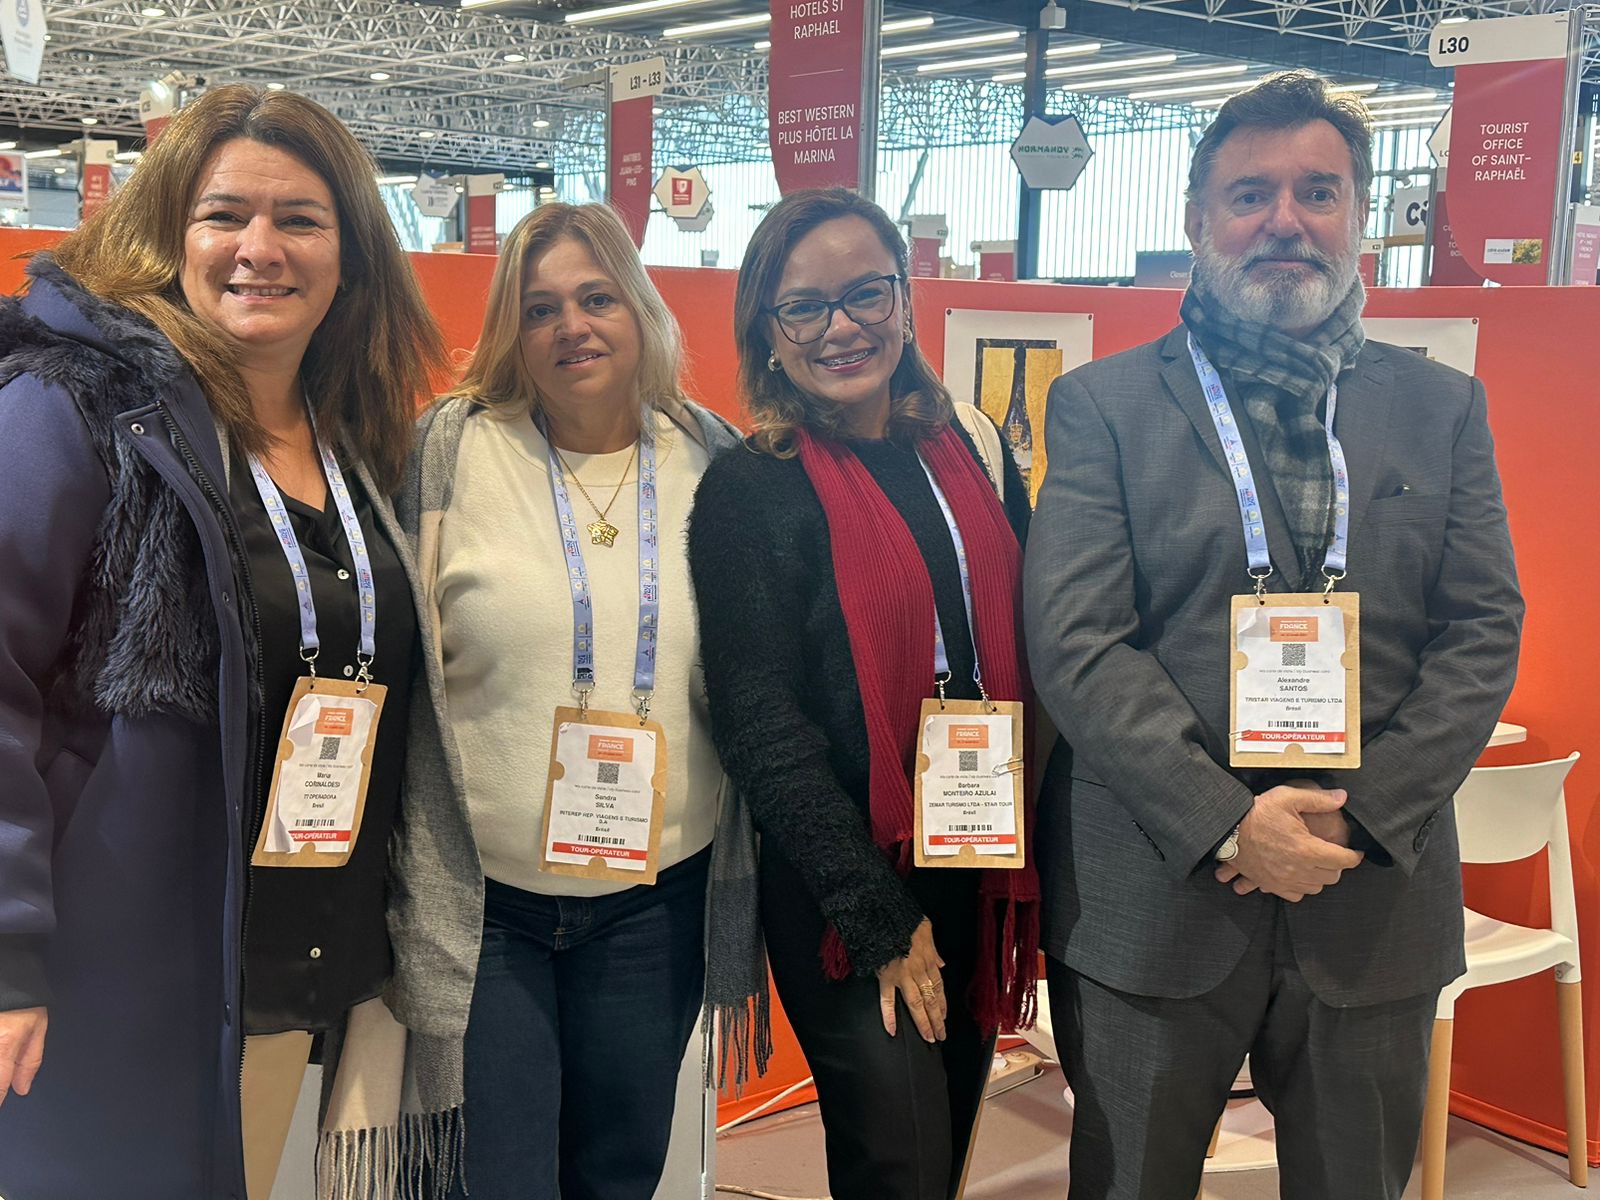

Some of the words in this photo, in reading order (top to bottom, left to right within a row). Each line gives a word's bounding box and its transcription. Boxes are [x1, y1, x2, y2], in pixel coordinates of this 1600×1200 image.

[790, 0, 829, 19] HOTELS
[794, 20, 841, 39] RAPHAEL
[1438, 37, 1469, 54] L30
[630, 75, 641, 90] L31
[648, 71, 661, 86] L33
[778, 109, 802, 124] BEST
[805, 104, 855, 122] WESTERN
[778, 130, 802, 145] PLUS
[805, 125, 838, 142] HÔTEL
[841, 125, 853, 140] LA
[1480, 122, 1529, 135] TOURIST
[1482, 138, 1524, 150] OFFICE
[794, 148, 836, 164] MARINA
[1472, 155, 1488, 166] OF
[1490, 154, 1532, 165] SAINT-
[595, 793, 617, 801] Sandra
